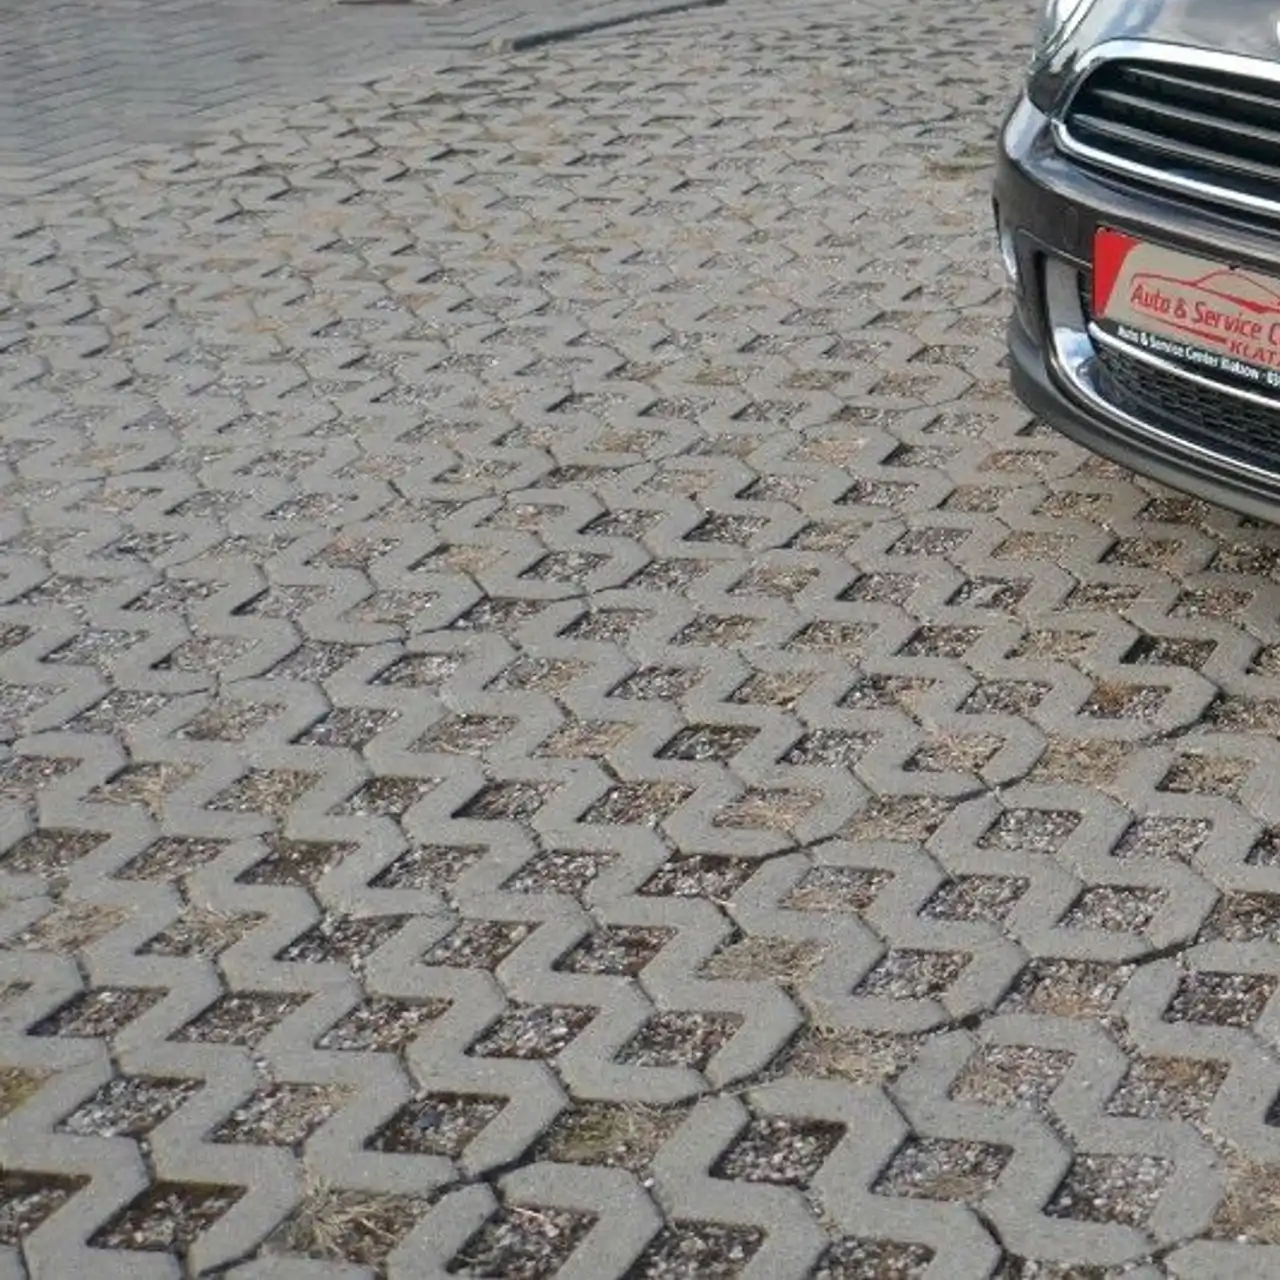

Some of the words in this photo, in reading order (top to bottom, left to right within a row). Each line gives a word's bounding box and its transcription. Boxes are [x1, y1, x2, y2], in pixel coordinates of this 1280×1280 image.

[1130, 282, 1169, 315] Auto
[1174, 299, 1188, 320] &
[1195, 301, 1263, 339] Service
[1117, 325, 1139, 343] Auto
[1140, 331, 1149, 346] &
[1150, 334, 1184, 358] Service
[1186, 345, 1218, 367] Center
